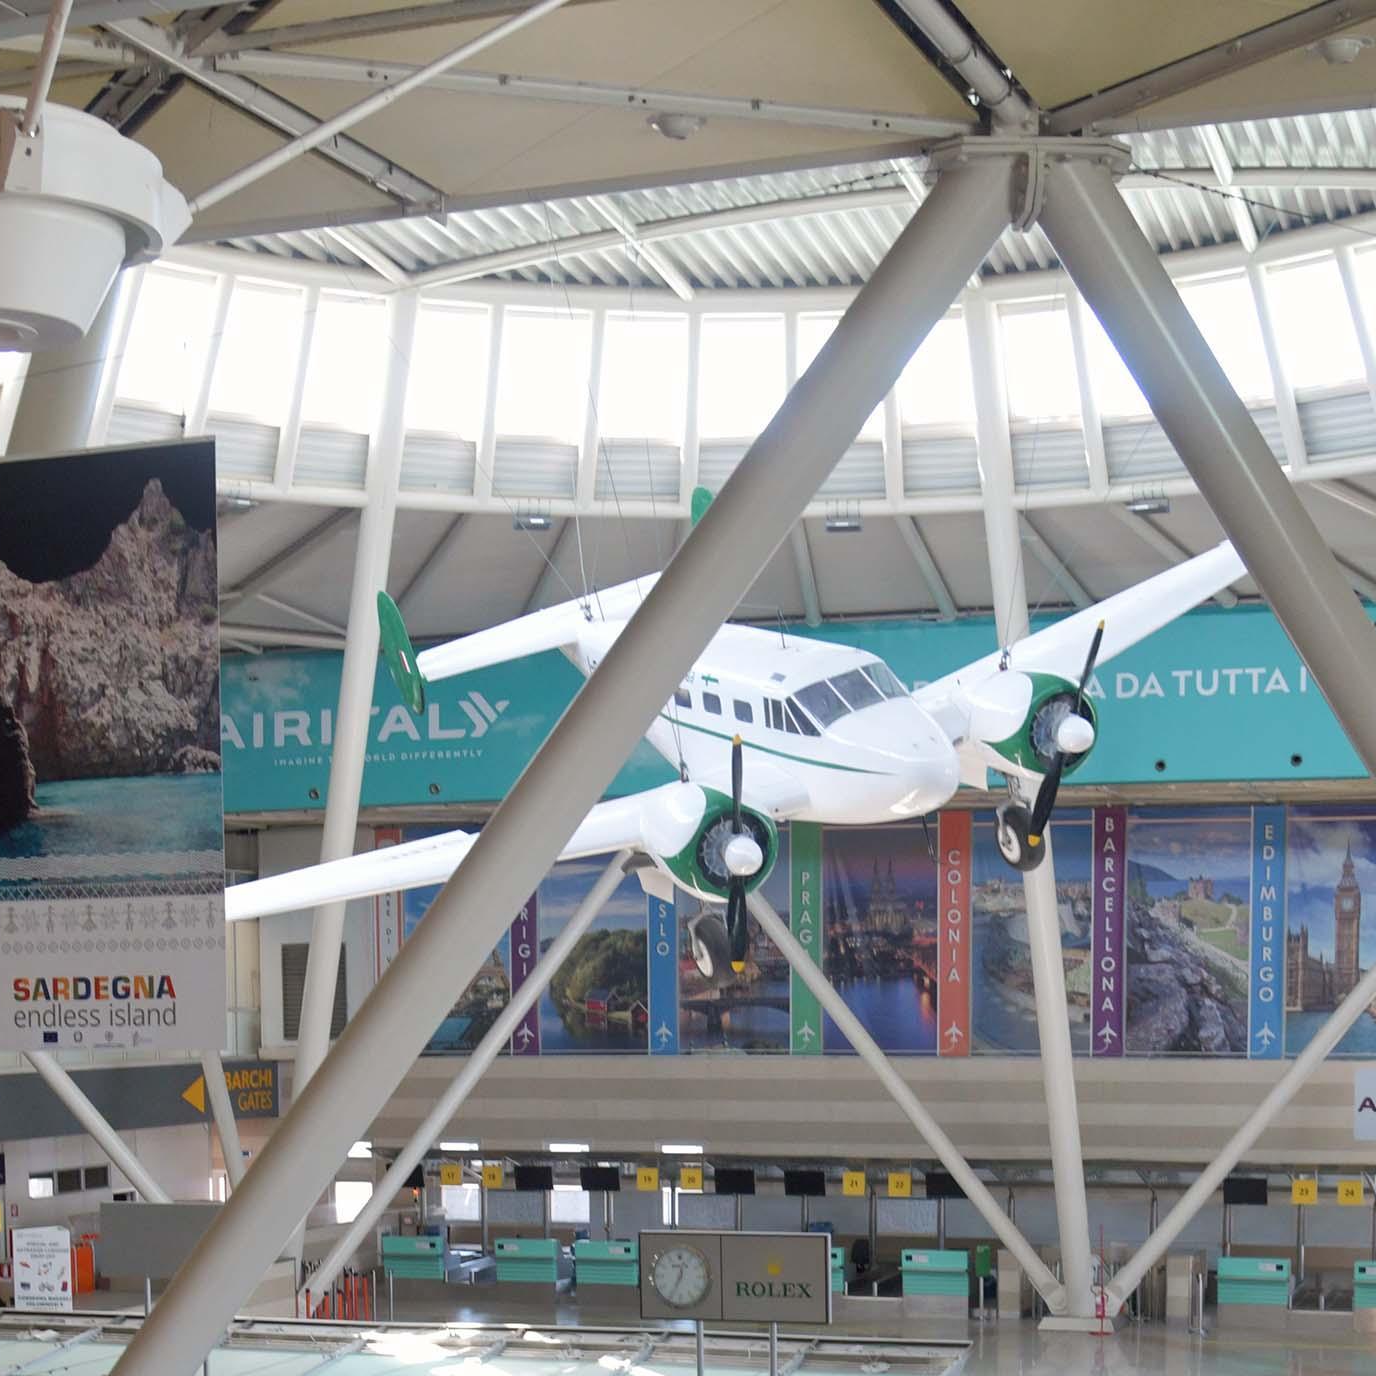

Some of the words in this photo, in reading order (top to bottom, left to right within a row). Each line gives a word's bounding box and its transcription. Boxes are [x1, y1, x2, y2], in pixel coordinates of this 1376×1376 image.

[1116, 671, 1165, 698] DA
[1171, 666, 1289, 695] TUTTA
[220, 691, 510, 748] AIRIALY
[365, 752, 395, 763] ORLD
[799, 871, 814, 945] PRAG
[947, 850, 962, 984] COLONIA
[1101, 817, 1116, 1012] BARCELLONA
[1258, 824, 1277, 1003] EDIMBURGO
[518, 906, 531, 977] RIGI
[656, 903, 670, 957] SLO
[13, 975, 176, 1001] SARDEGNA
[14, 1003, 101, 1029] endless
[108, 1001, 177, 1027] island
[224, 1068, 273, 1091] BARCHI
[237, 1090, 273, 1112] GATES
[1344, 1187, 1355, 1198] 24
[736, 1281, 813, 1299] ROLEX
